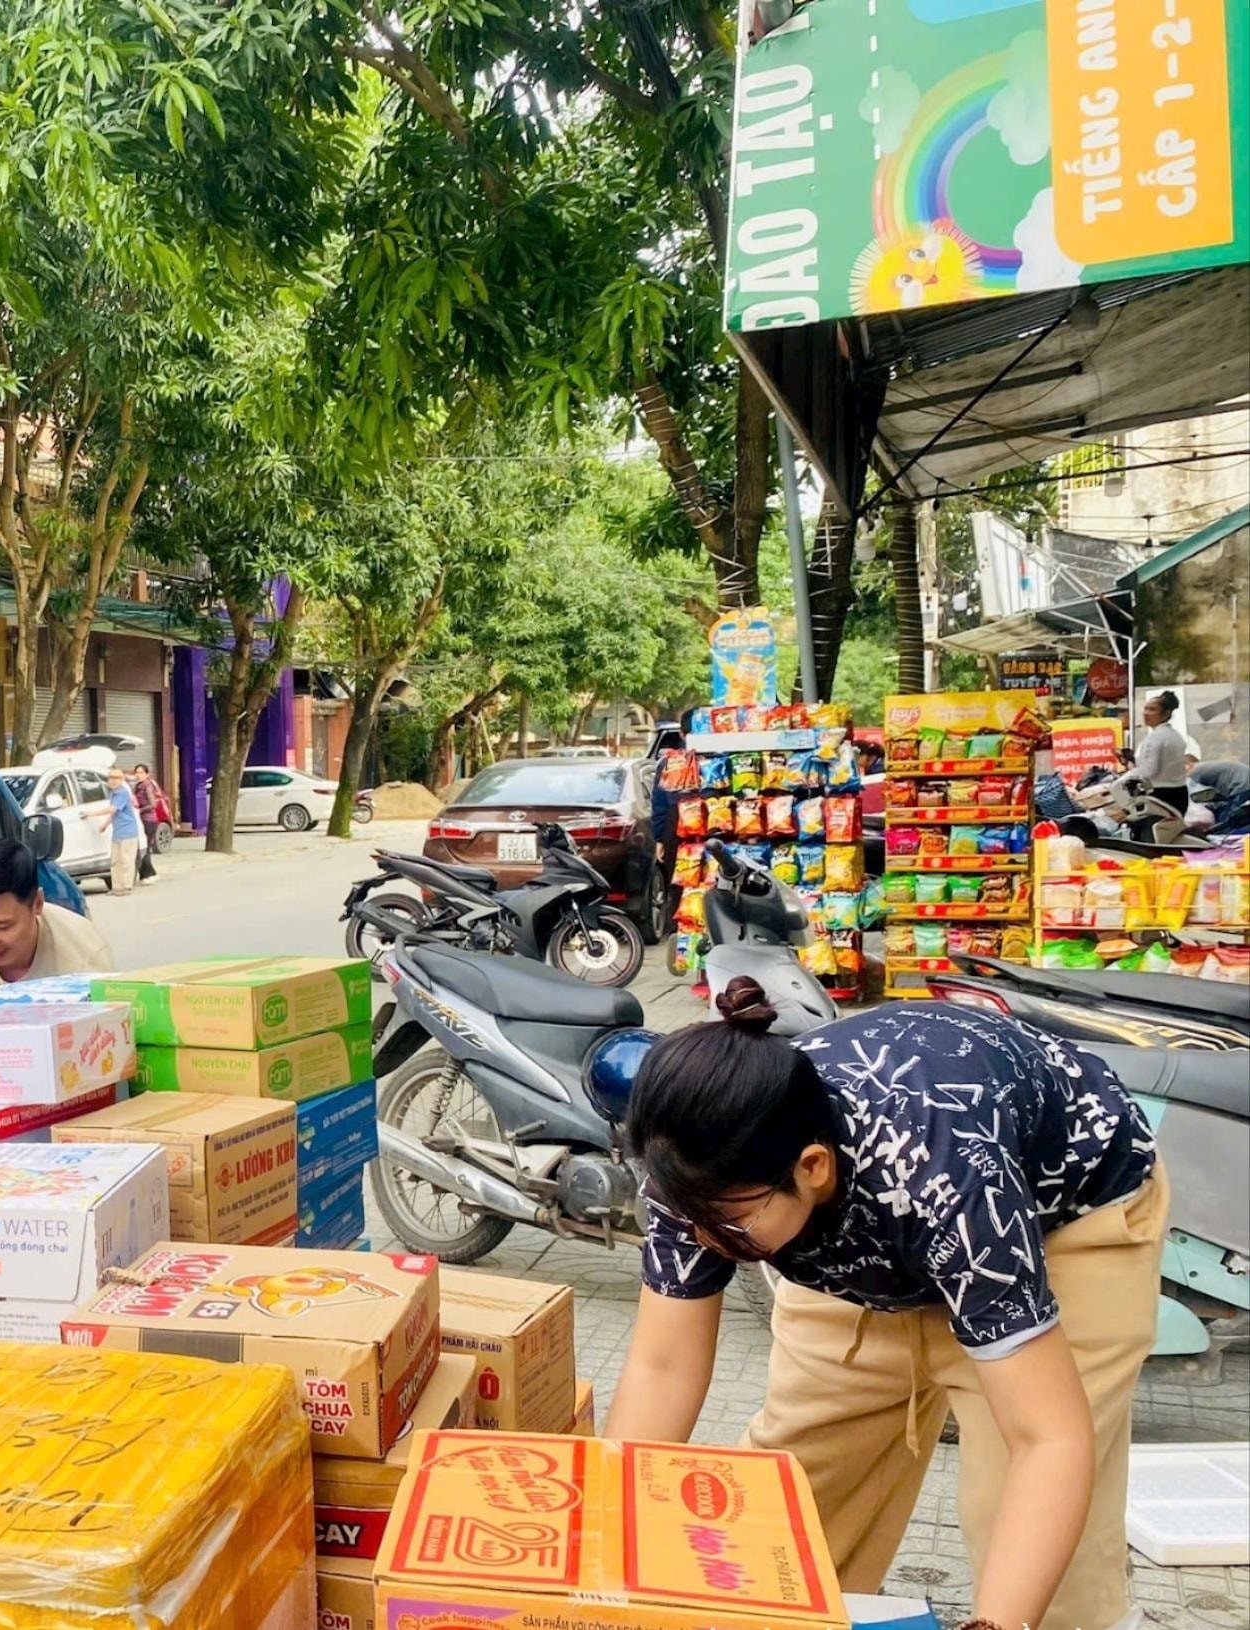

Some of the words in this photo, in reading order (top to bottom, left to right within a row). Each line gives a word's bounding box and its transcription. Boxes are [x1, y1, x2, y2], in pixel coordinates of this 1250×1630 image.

[737, 64, 834, 196] TẠO
[1063, 88, 1123, 224] TIẾNG
[1137, 130, 1197, 217] CẤP
[235, 1147, 274, 1185] LƯƠNG
[3, 1218, 69, 1238] WATER
[47, 1240, 68, 1253] chai
[65, 1329, 96, 1347] MỚI
[480, 1341, 502, 1353] CHÂU
[305, 1366, 318, 1377] mì
[306, 1379, 347, 1398] TÔM
[301, 1401, 353, 1418] CHUA
[311, 1420, 346, 1435] CAY
[314, 1524, 361, 1546] CAY
[453, 1515, 560, 1568] 25
[317, 1608, 350, 1630] ÔM
[522, 1615, 546, 1628] SẢN
[547, 1614, 570, 1630] PHẨM
